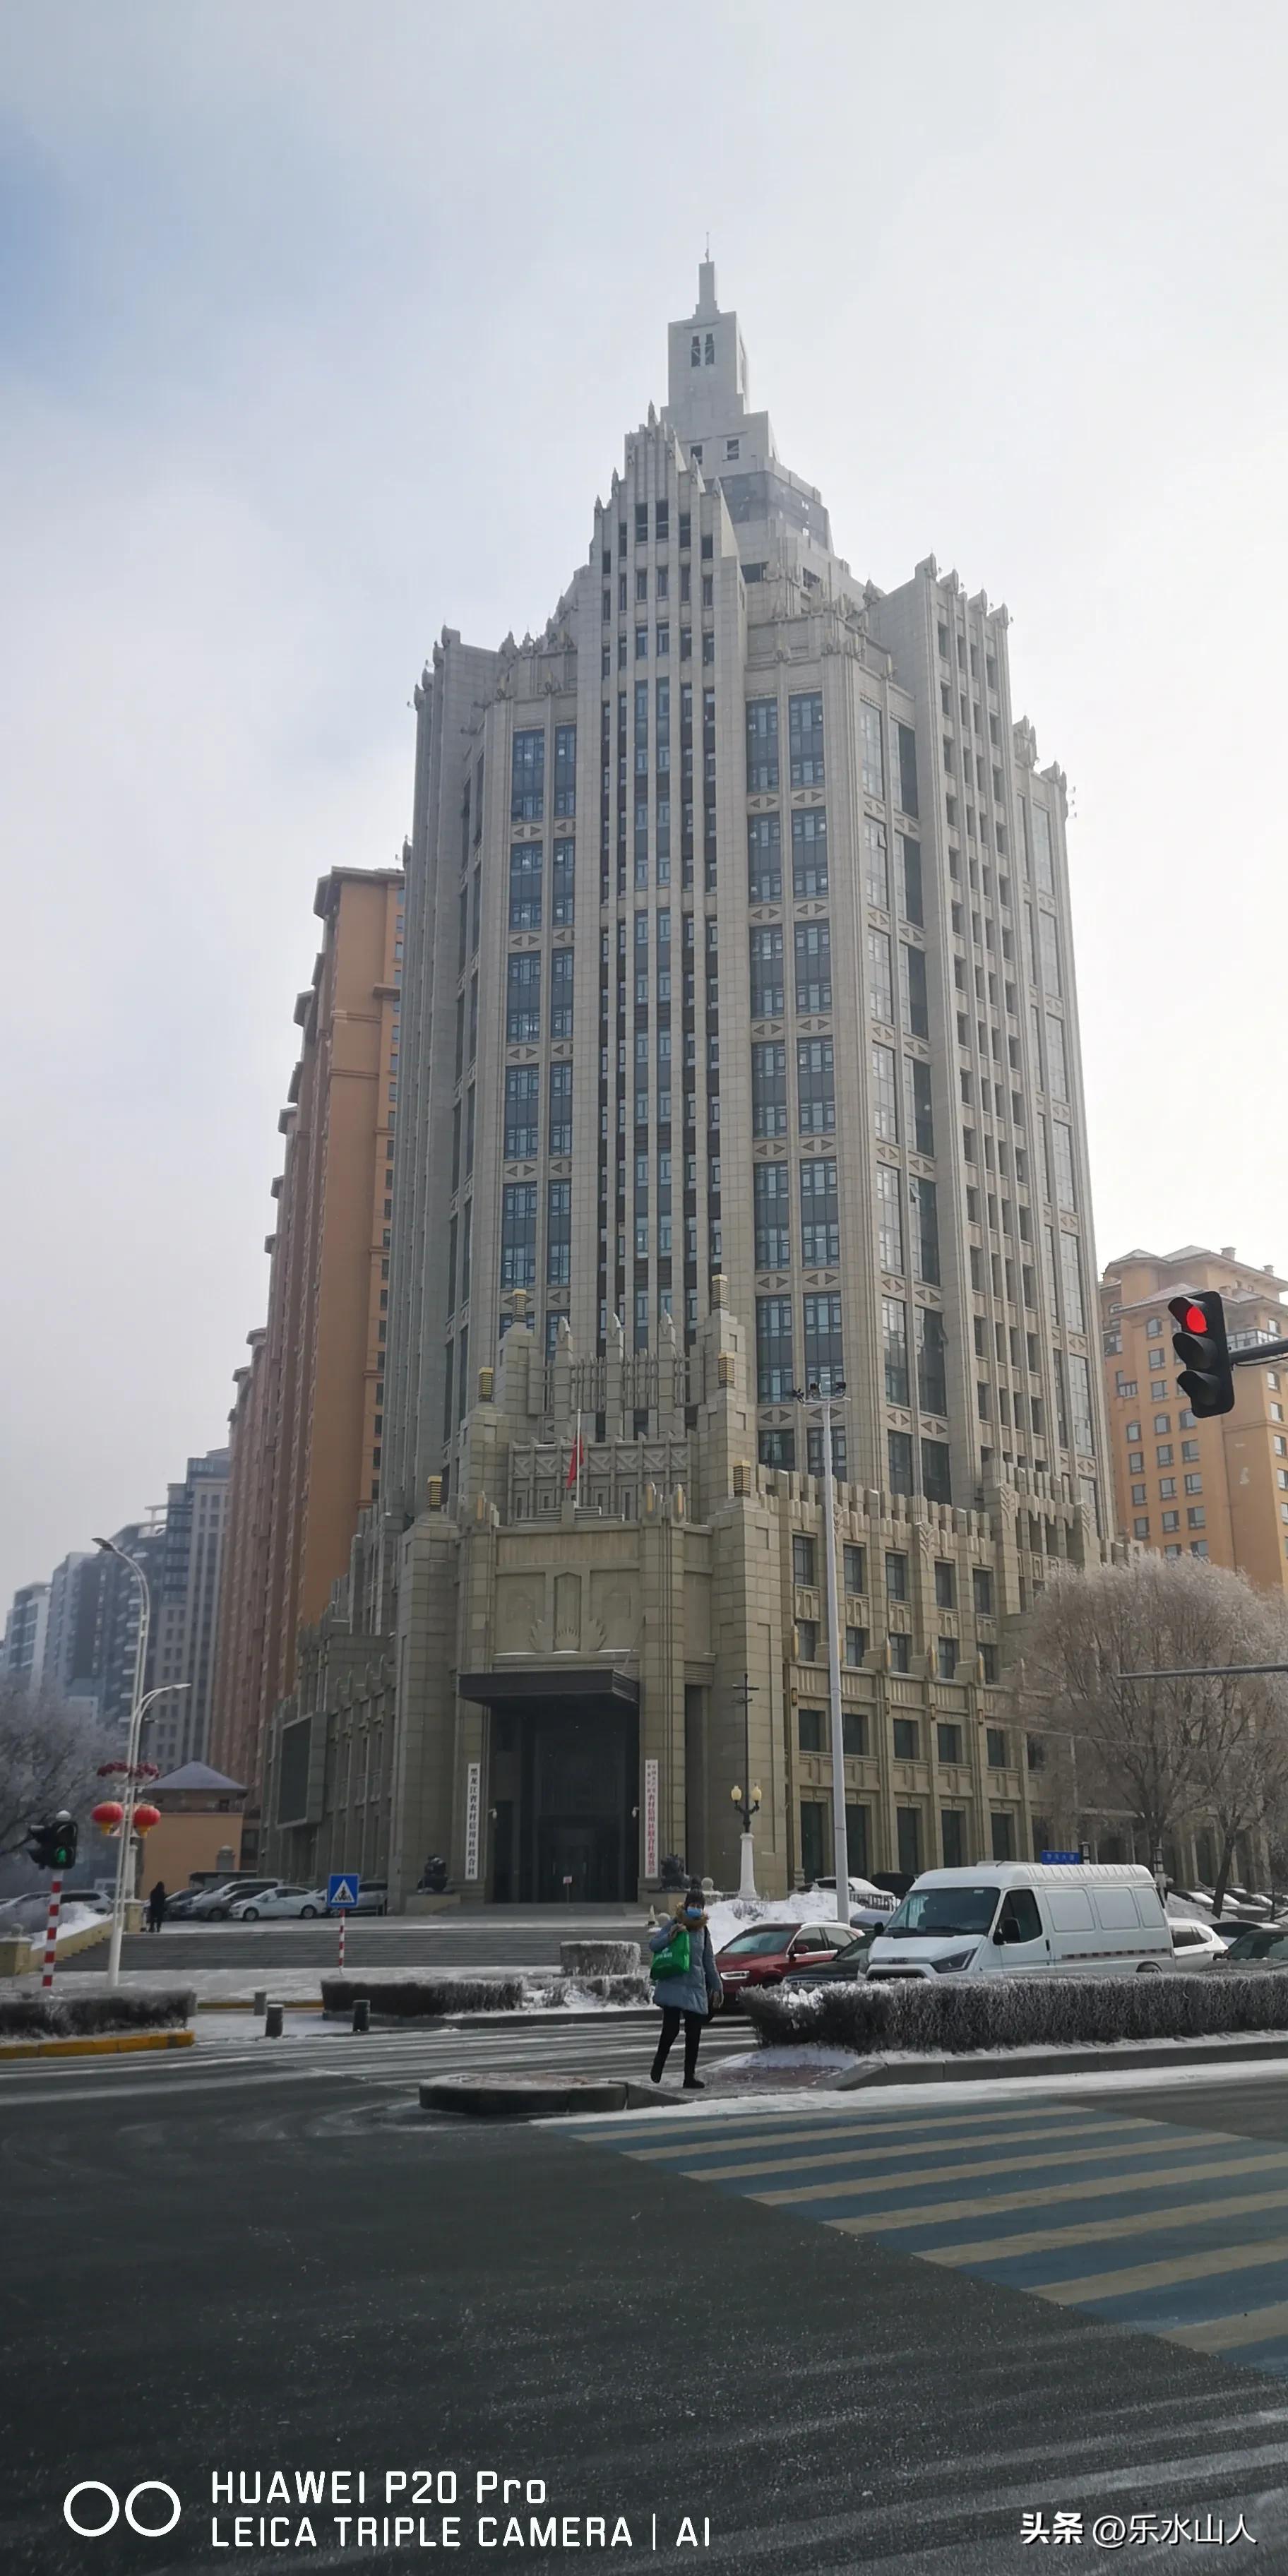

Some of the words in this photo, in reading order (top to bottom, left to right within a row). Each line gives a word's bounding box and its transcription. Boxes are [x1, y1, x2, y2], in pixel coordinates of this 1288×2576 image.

[467, 1767, 479, 1876] 黑龙江省农村信用社联合社
